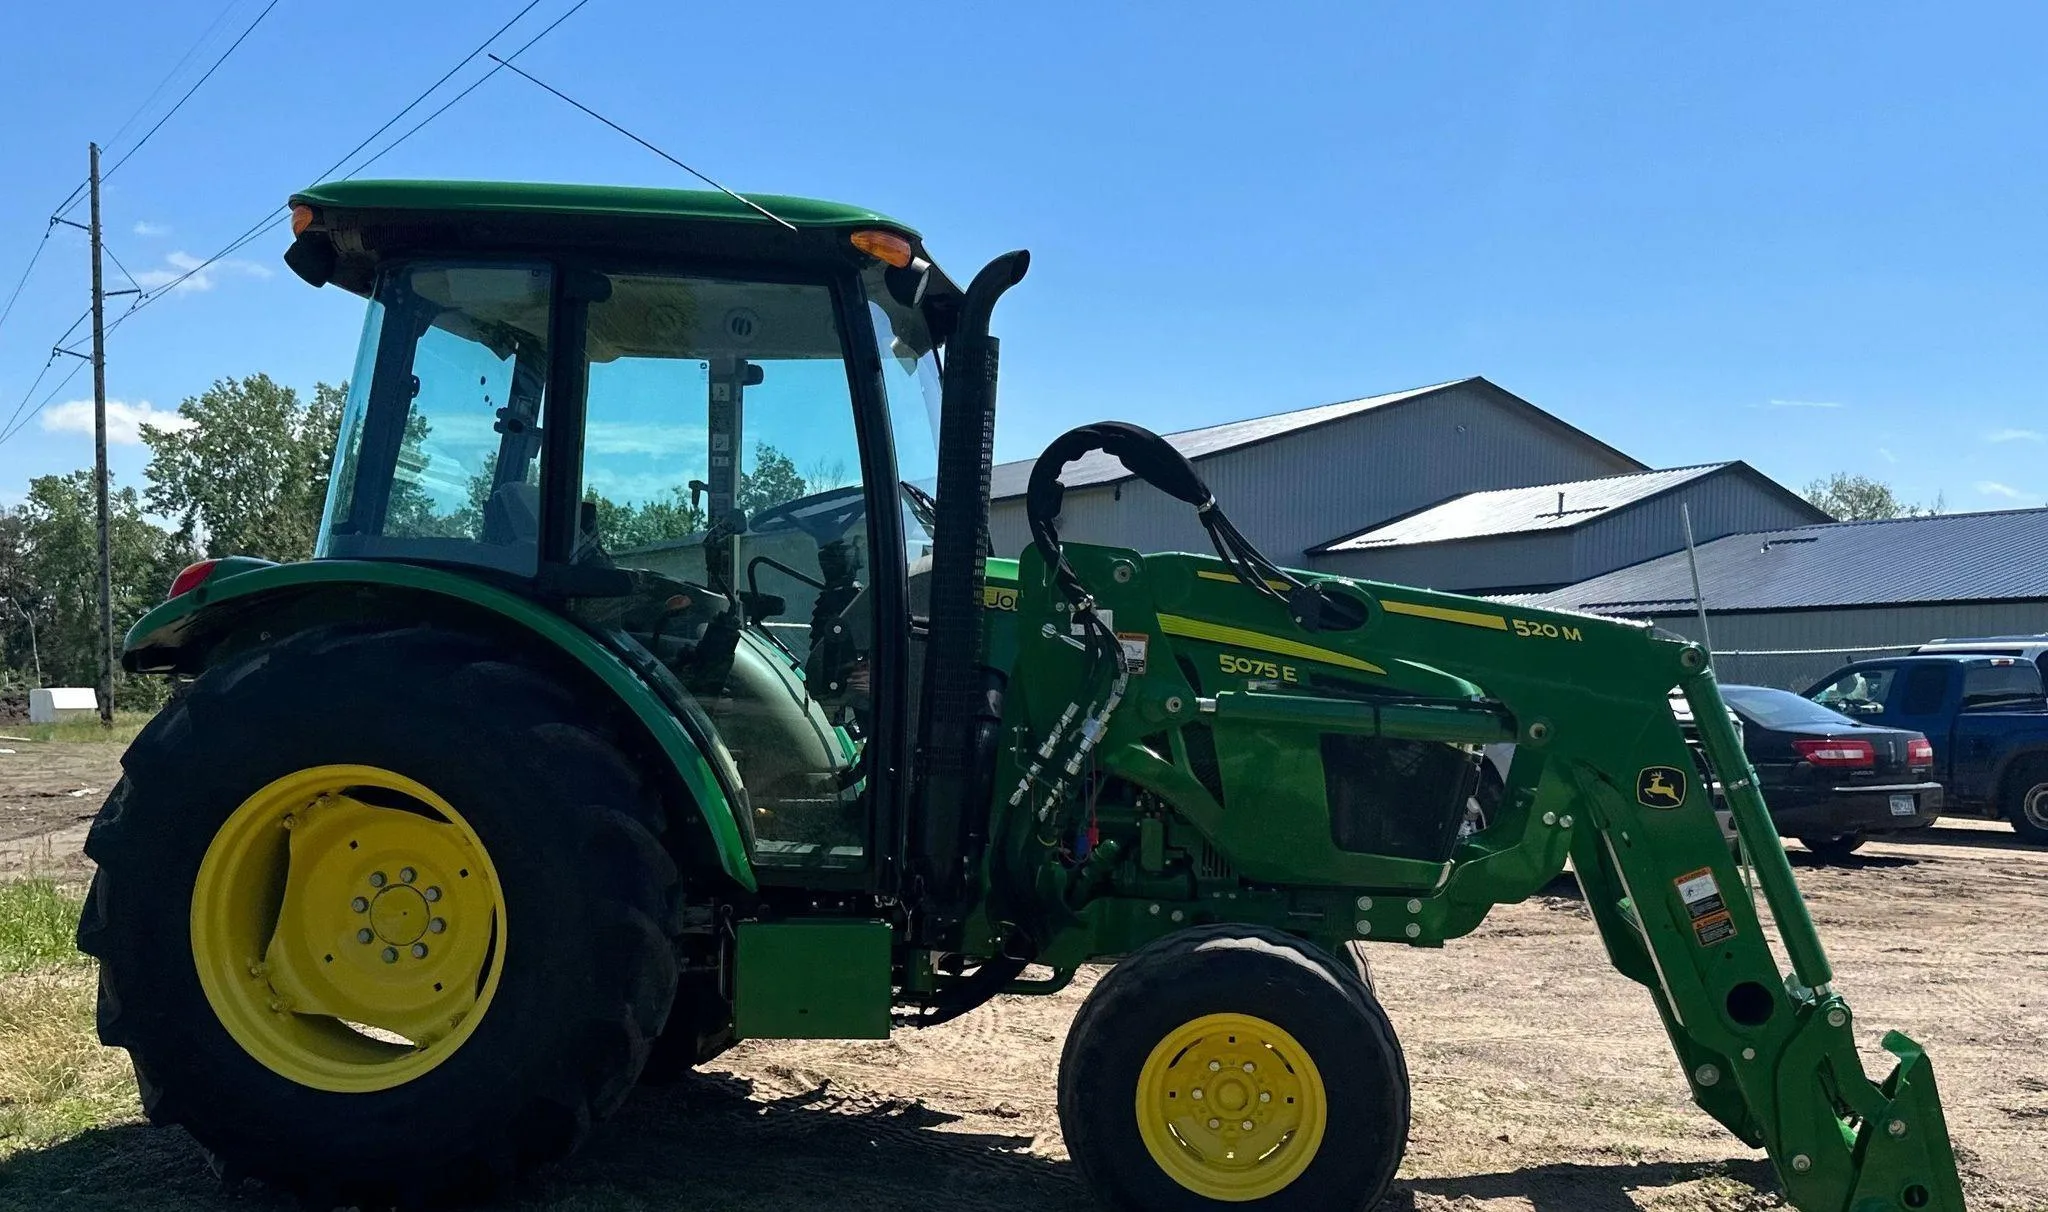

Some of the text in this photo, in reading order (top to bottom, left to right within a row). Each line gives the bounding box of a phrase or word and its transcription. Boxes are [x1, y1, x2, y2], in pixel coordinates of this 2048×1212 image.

[1512, 619, 1583, 641] 520 M
[1219, 654, 1297, 682] 5075 E
